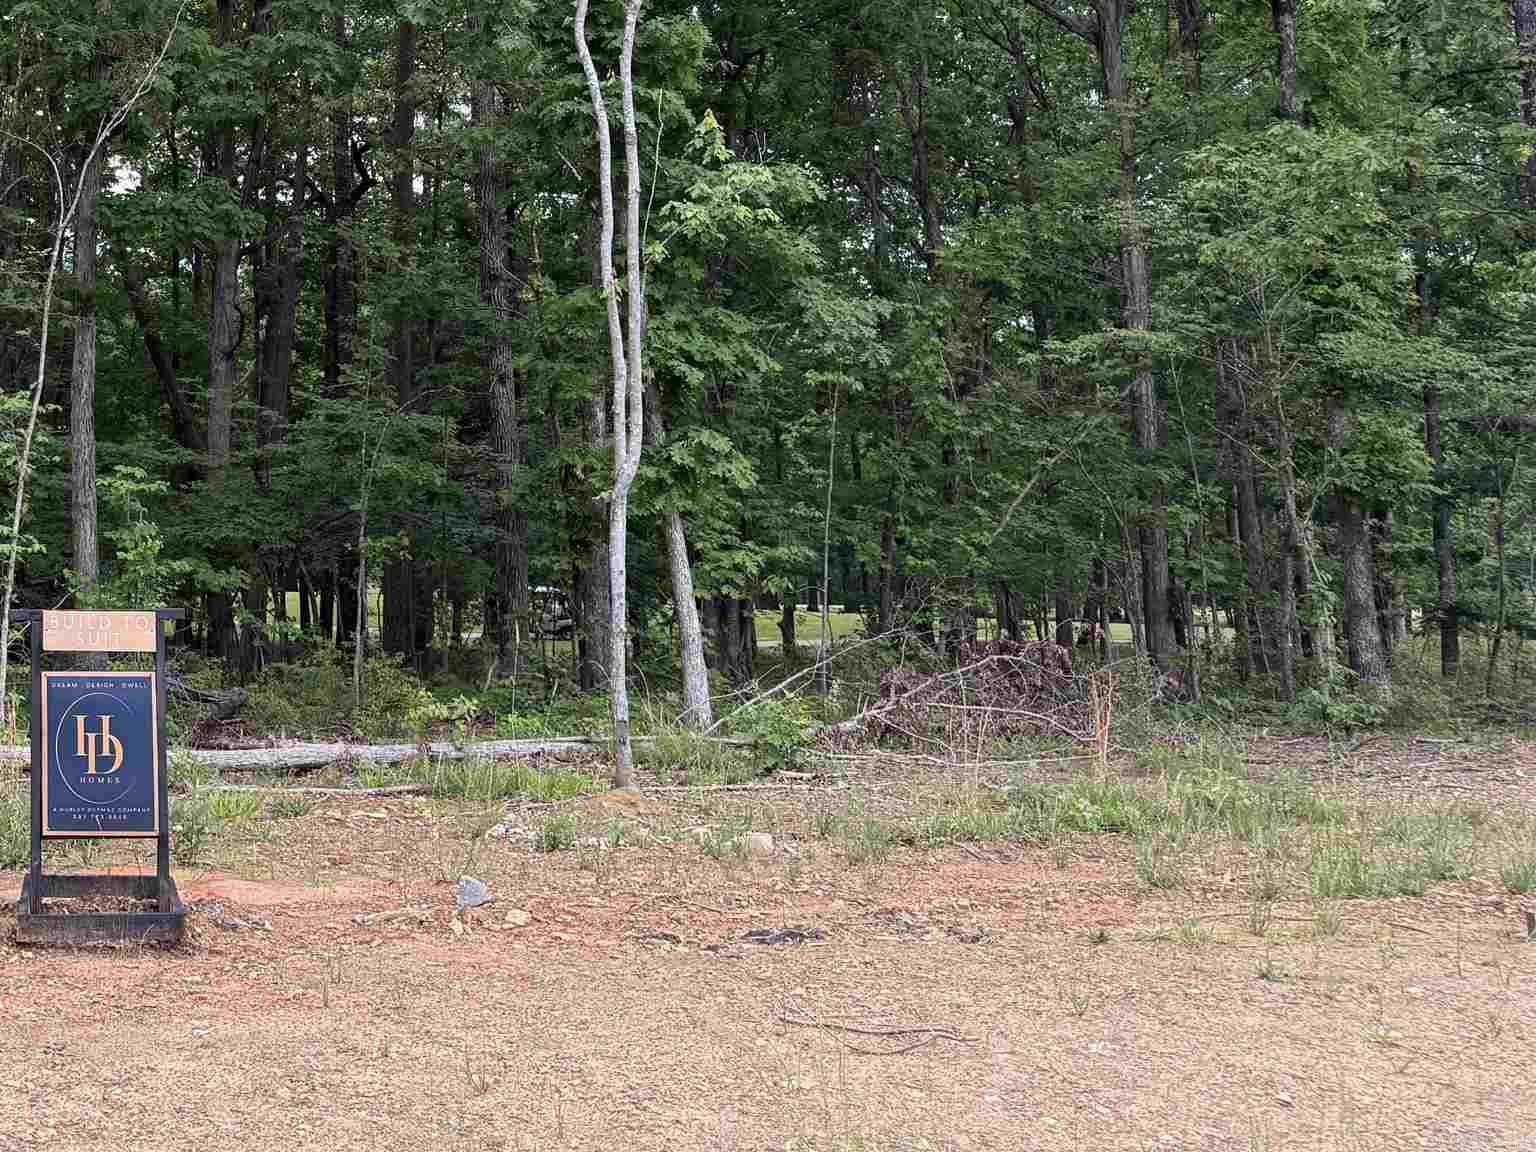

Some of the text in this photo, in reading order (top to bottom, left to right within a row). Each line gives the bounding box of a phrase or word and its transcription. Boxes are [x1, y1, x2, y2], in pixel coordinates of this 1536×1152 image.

[47, 614, 150, 631] BUILD TO
[77, 631, 122, 647] SUIT
[86, 681, 115, 689] DESIGN
[80, 776, 121, 784] HOMES
